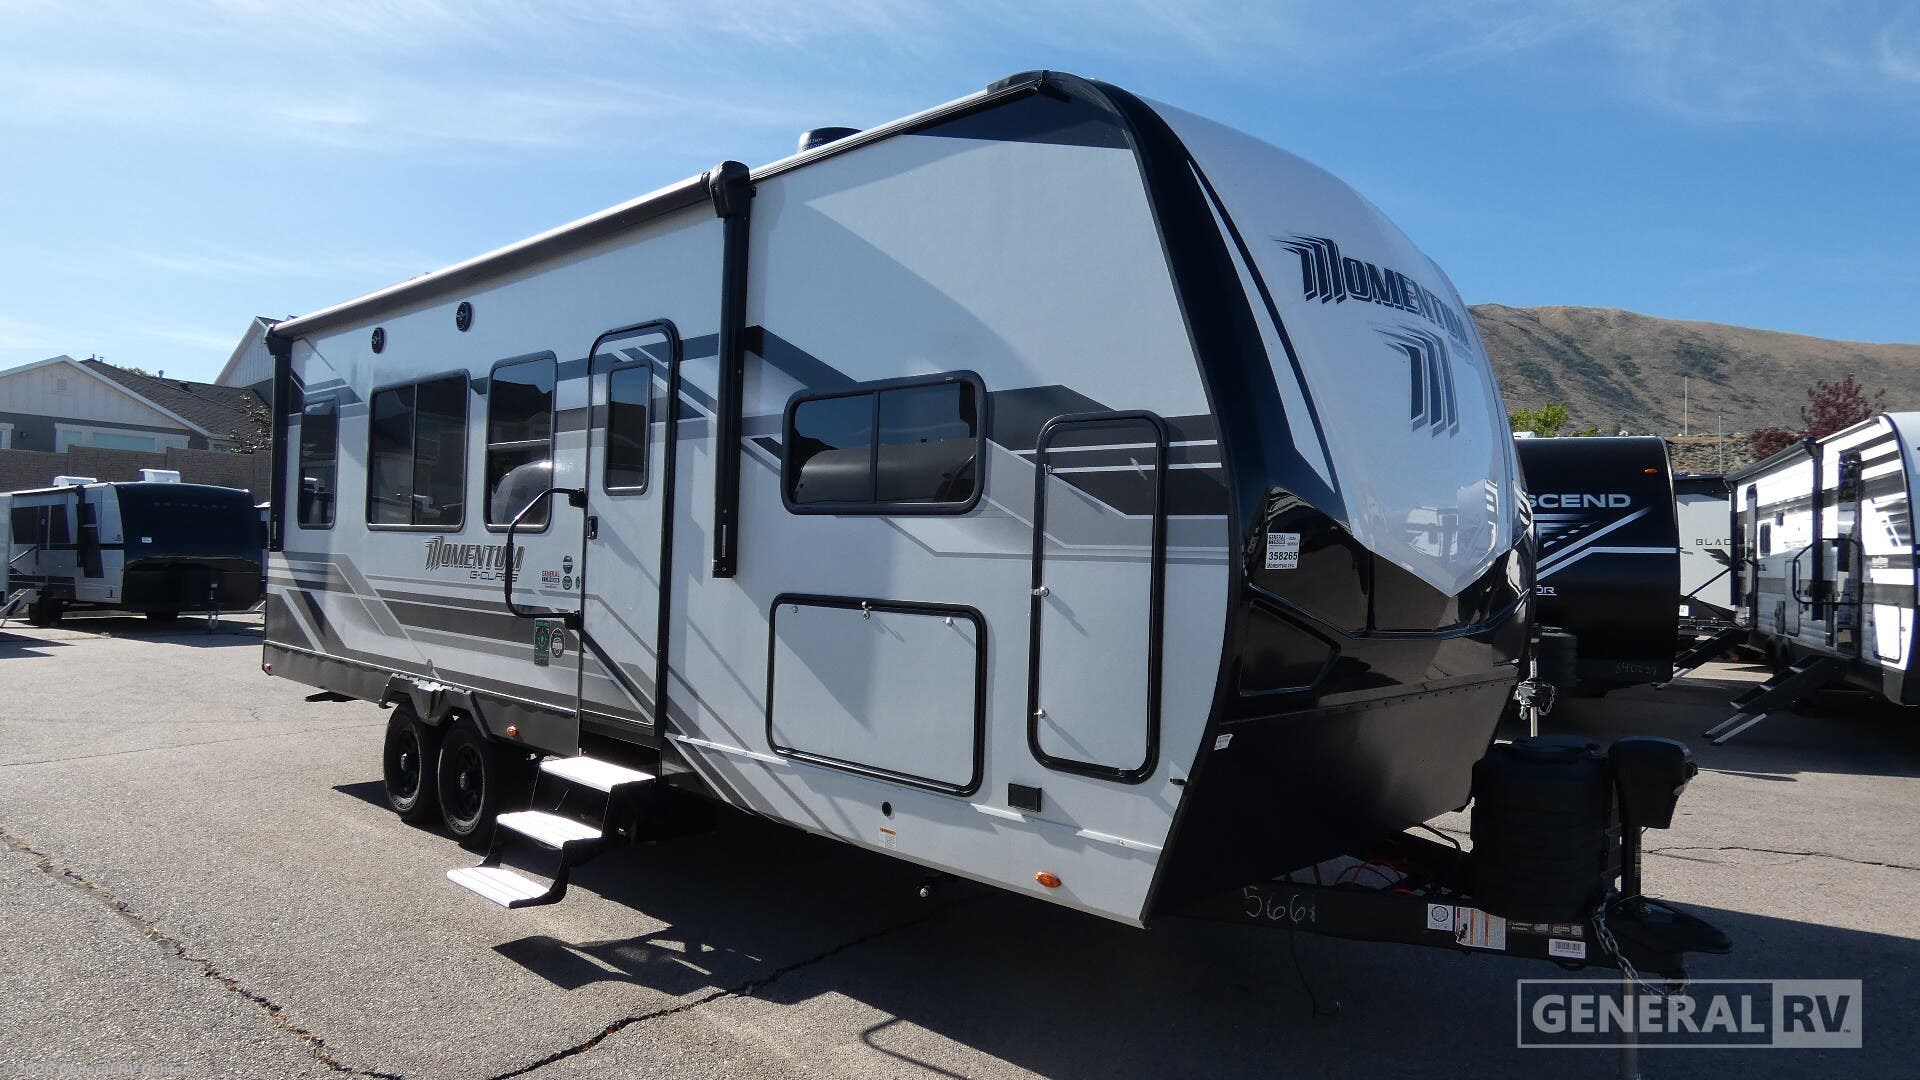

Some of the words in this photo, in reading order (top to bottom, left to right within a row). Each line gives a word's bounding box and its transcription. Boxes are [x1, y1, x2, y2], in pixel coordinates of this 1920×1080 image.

[1528, 493, 1631, 508] SCEND
[1695, 538, 1732, 546] BLAC
[1268, 552, 1297, 560] 358265
[469, 571, 519, 582] G-CLAS
